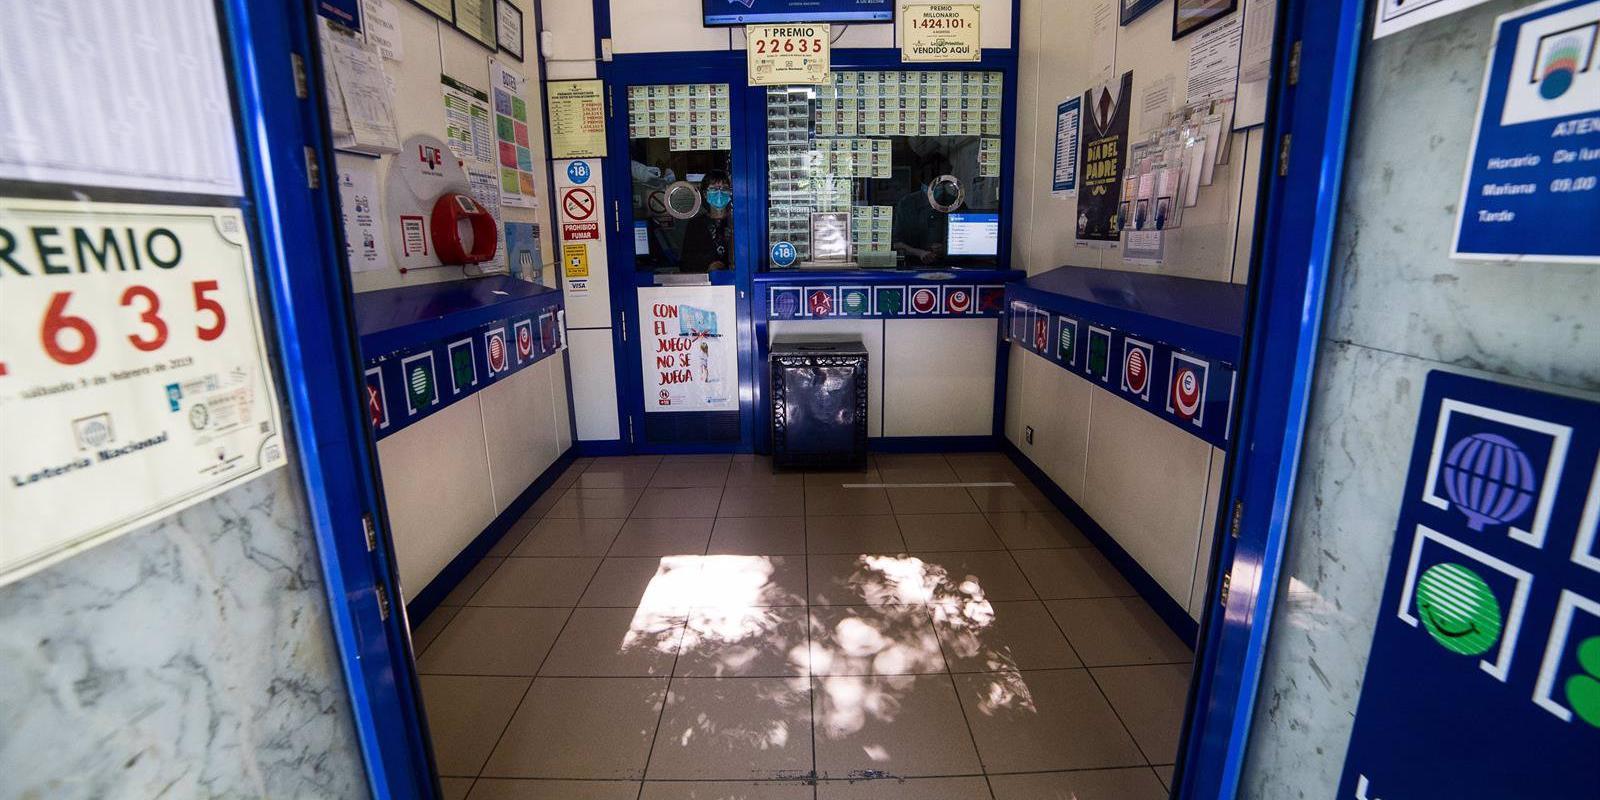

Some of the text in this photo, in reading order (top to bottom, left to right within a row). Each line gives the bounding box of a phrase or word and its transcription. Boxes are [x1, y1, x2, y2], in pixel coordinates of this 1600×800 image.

[912, 19, 964, 29] 1.424.101
[773, 28, 814, 38] PREMIO
[949, 45, 970, 54] AQUÍ
[1487, 154, 1541, 171] Horario
[1552, 149, 1577, 164] De
[570, 166, 586, 177] +18
[1086, 158, 1118, 180] PADRE
[1482, 183, 1537, 197] Mañana
[1478, 210, 1516, 223] Tarde
[571, 231, 592, 239] FUMAR
[775, 248, 790, 258] +18
[653, 303, 678, 319] CON
[654, 321, 667, 336] EL
[656, 337, 692, 353] JUEGO
[657, 353, 691, 370] NO SE
[658, 368, 693, 386] JUEGA
[97, 429, 169, 463] Nacional
